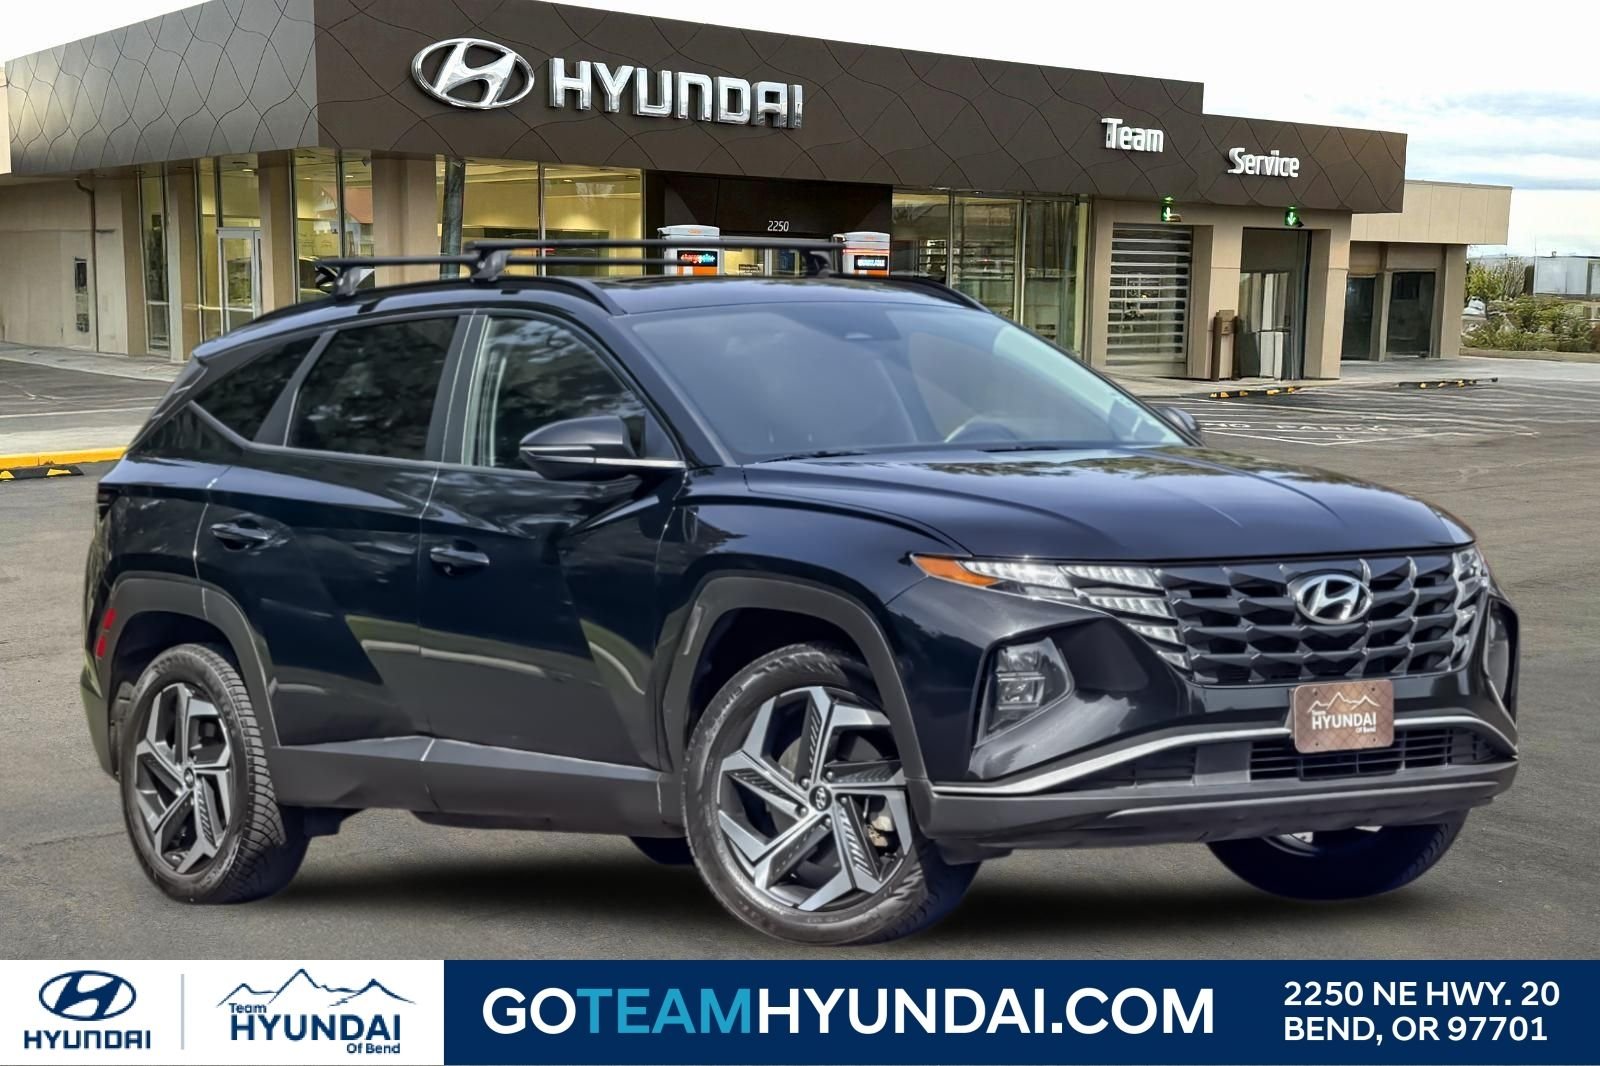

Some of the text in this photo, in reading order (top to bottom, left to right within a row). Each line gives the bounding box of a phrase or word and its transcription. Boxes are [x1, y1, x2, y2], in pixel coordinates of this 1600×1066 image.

[548, 57, 803, 129] HYUNDAI
[1102, 117, 1164, 153] Team
[1227, 147, 1300, 178] Service
[767, 220, 790, 232] 2250
[1312, 712, 1376, 730] HYUNDAI
